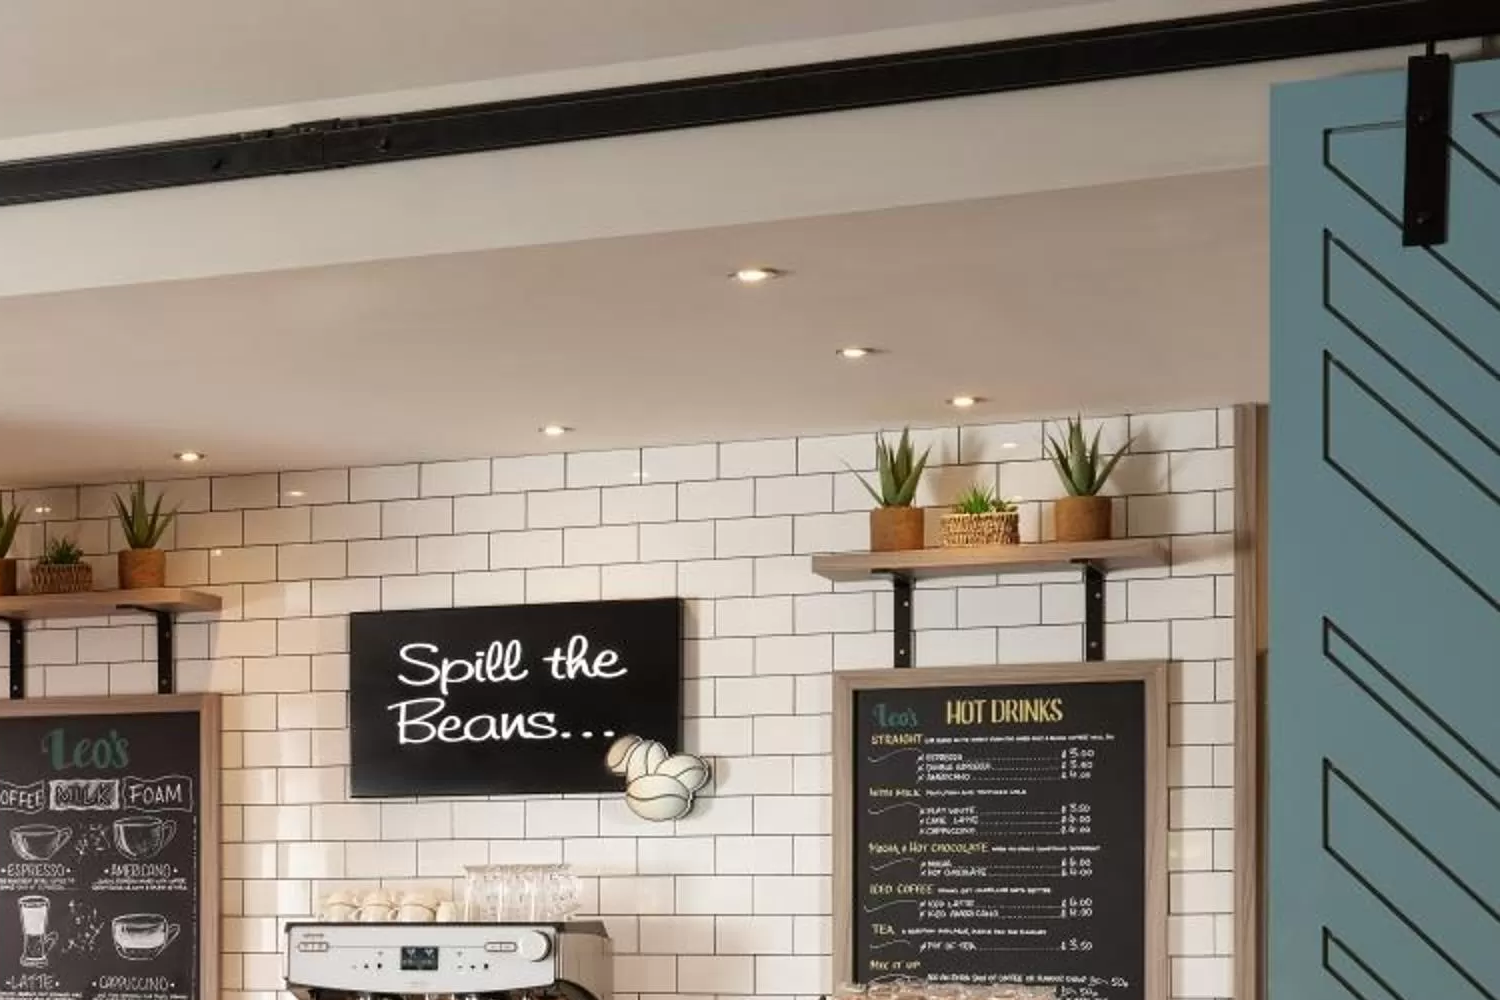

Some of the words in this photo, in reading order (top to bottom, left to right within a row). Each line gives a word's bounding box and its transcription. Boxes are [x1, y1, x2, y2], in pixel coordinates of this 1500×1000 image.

[397, 639, 529, 695] Spill
[542, 634, 628, 680] the
[946, 699, 987, 725] HOT
[991, 697, 1064, 724] DRINKS
[41, 728, 130, 771] Leo's
[55, 784, 111, 805] MILK
[130, 783, 182, 804] FOAM
[7, 863, 65, 877] ESPRESSO
[897, 883, 934, 895] COFFEE
[871, 924, 896, 936] TEA
